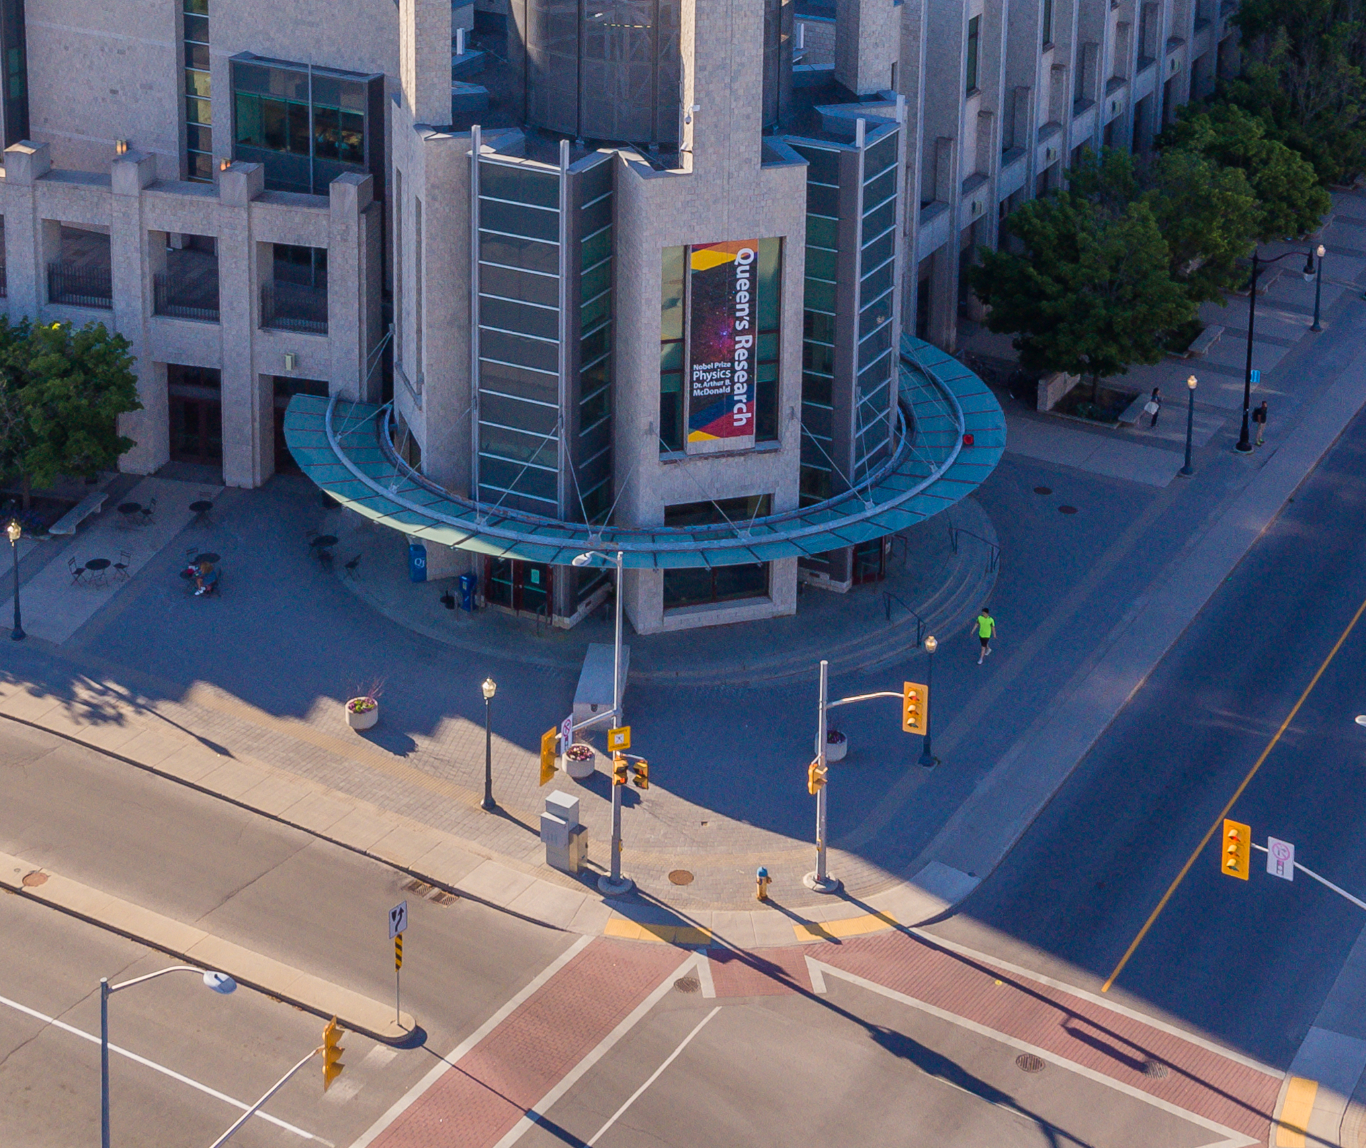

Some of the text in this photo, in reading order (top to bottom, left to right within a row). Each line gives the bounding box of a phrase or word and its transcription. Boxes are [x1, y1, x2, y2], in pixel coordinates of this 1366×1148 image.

[733, 247, 755, 427] Queen's Research
[693, 368, 731, 382] Physics
[693, 385, 731, 396] McDonald
